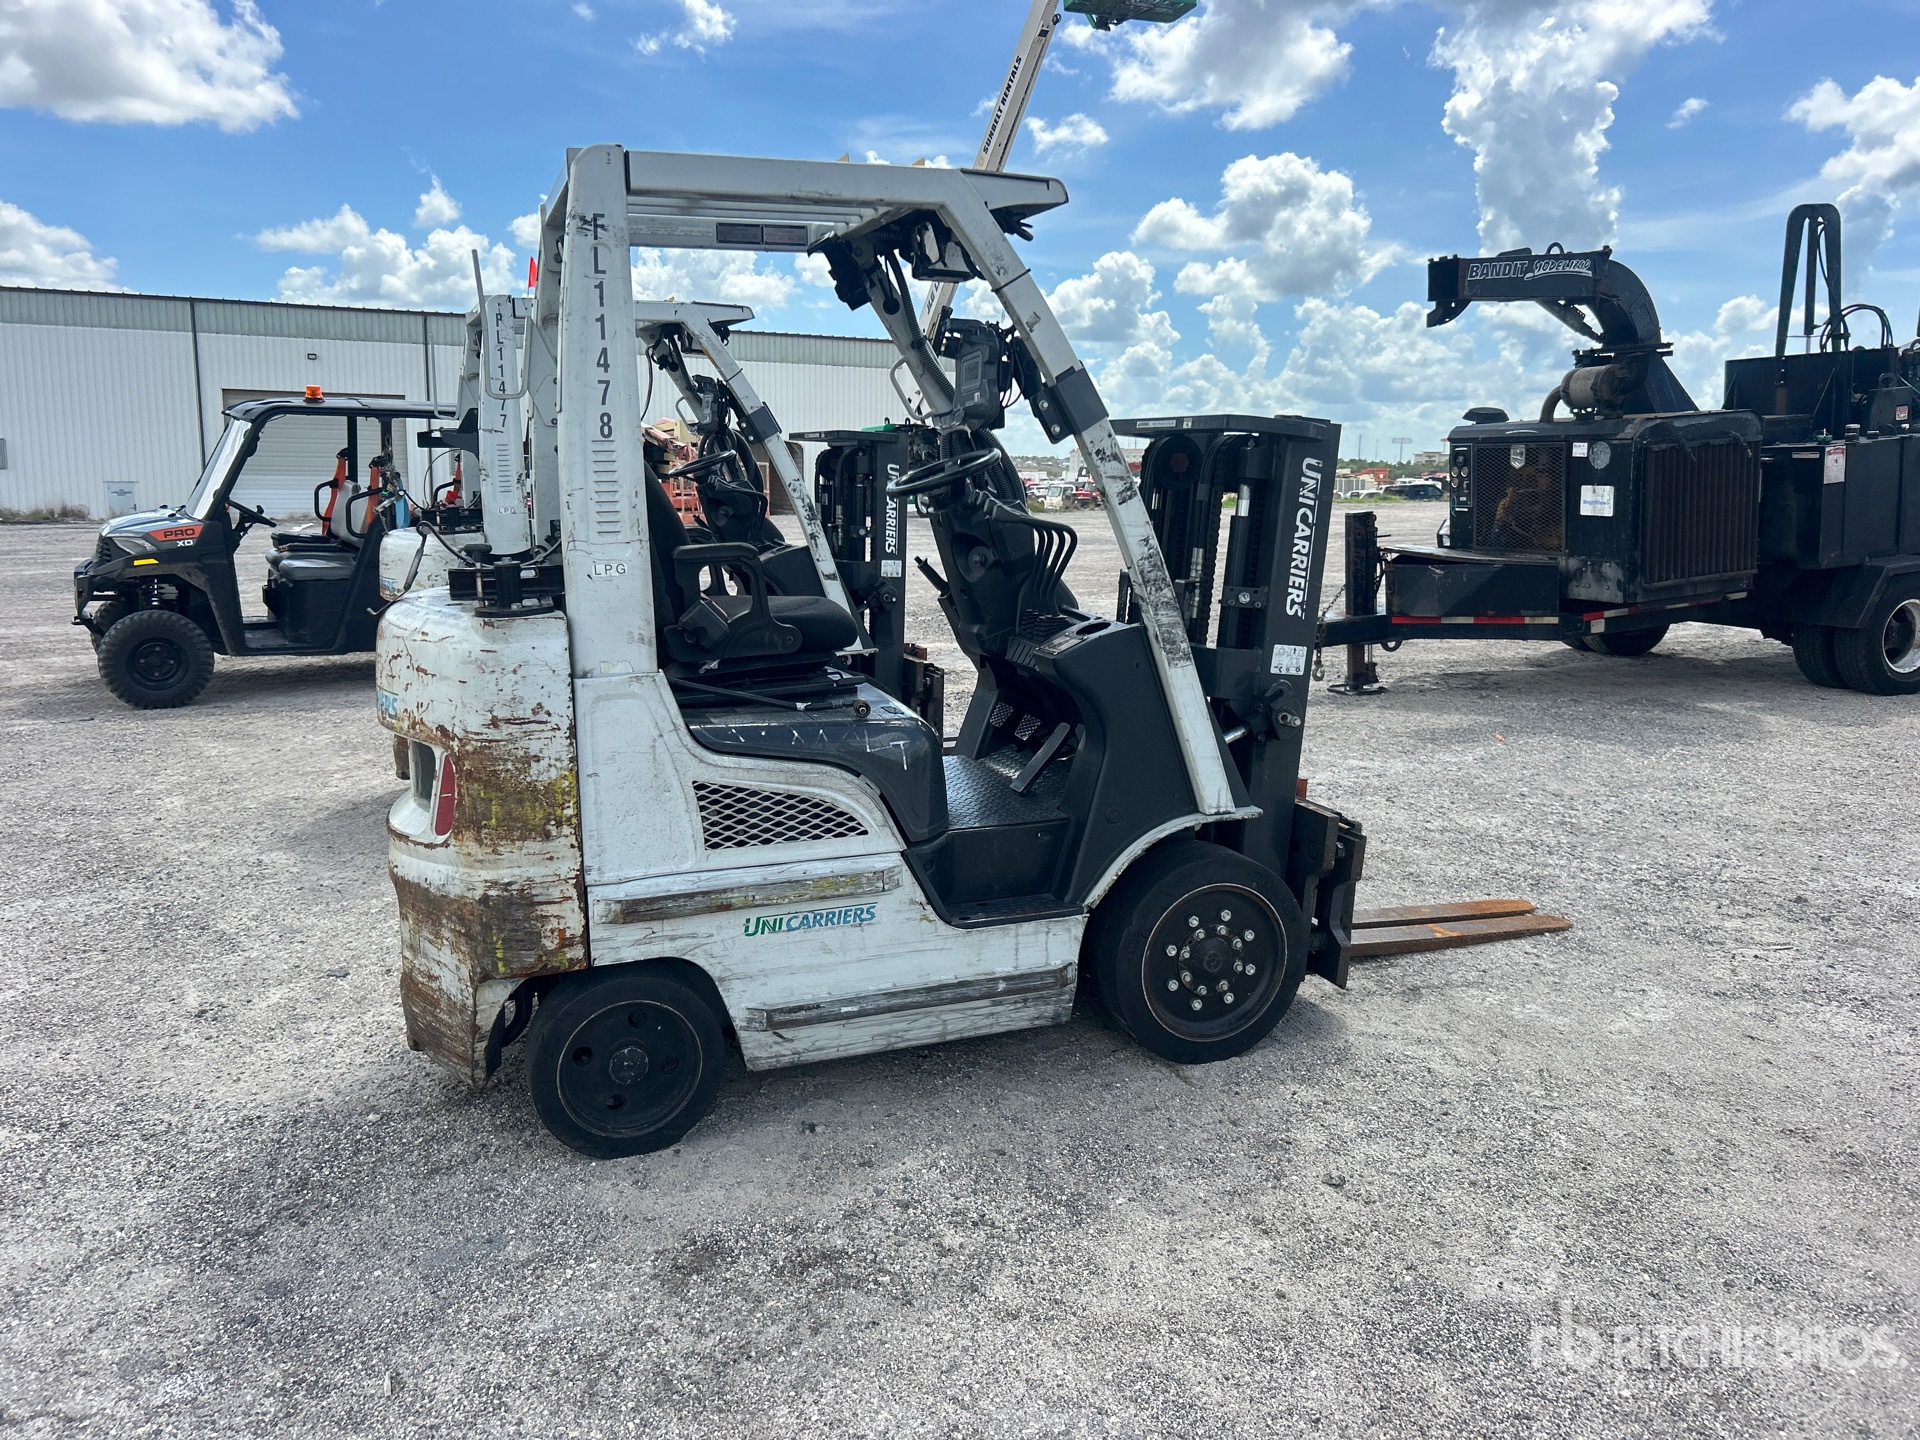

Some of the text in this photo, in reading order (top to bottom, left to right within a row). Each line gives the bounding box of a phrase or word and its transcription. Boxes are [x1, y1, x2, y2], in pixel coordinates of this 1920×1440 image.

[983, 55, 1022, 154] SUNBELT RENTALS
[1467, 260, 1529, 281] BANDIT
[592, 213, 613, 439] FL11478
[163, 528, 196, 539] PRO
[1285, 456, 1324, 619] UNICARRIERS
[593, 563, 626, 576] LPG
